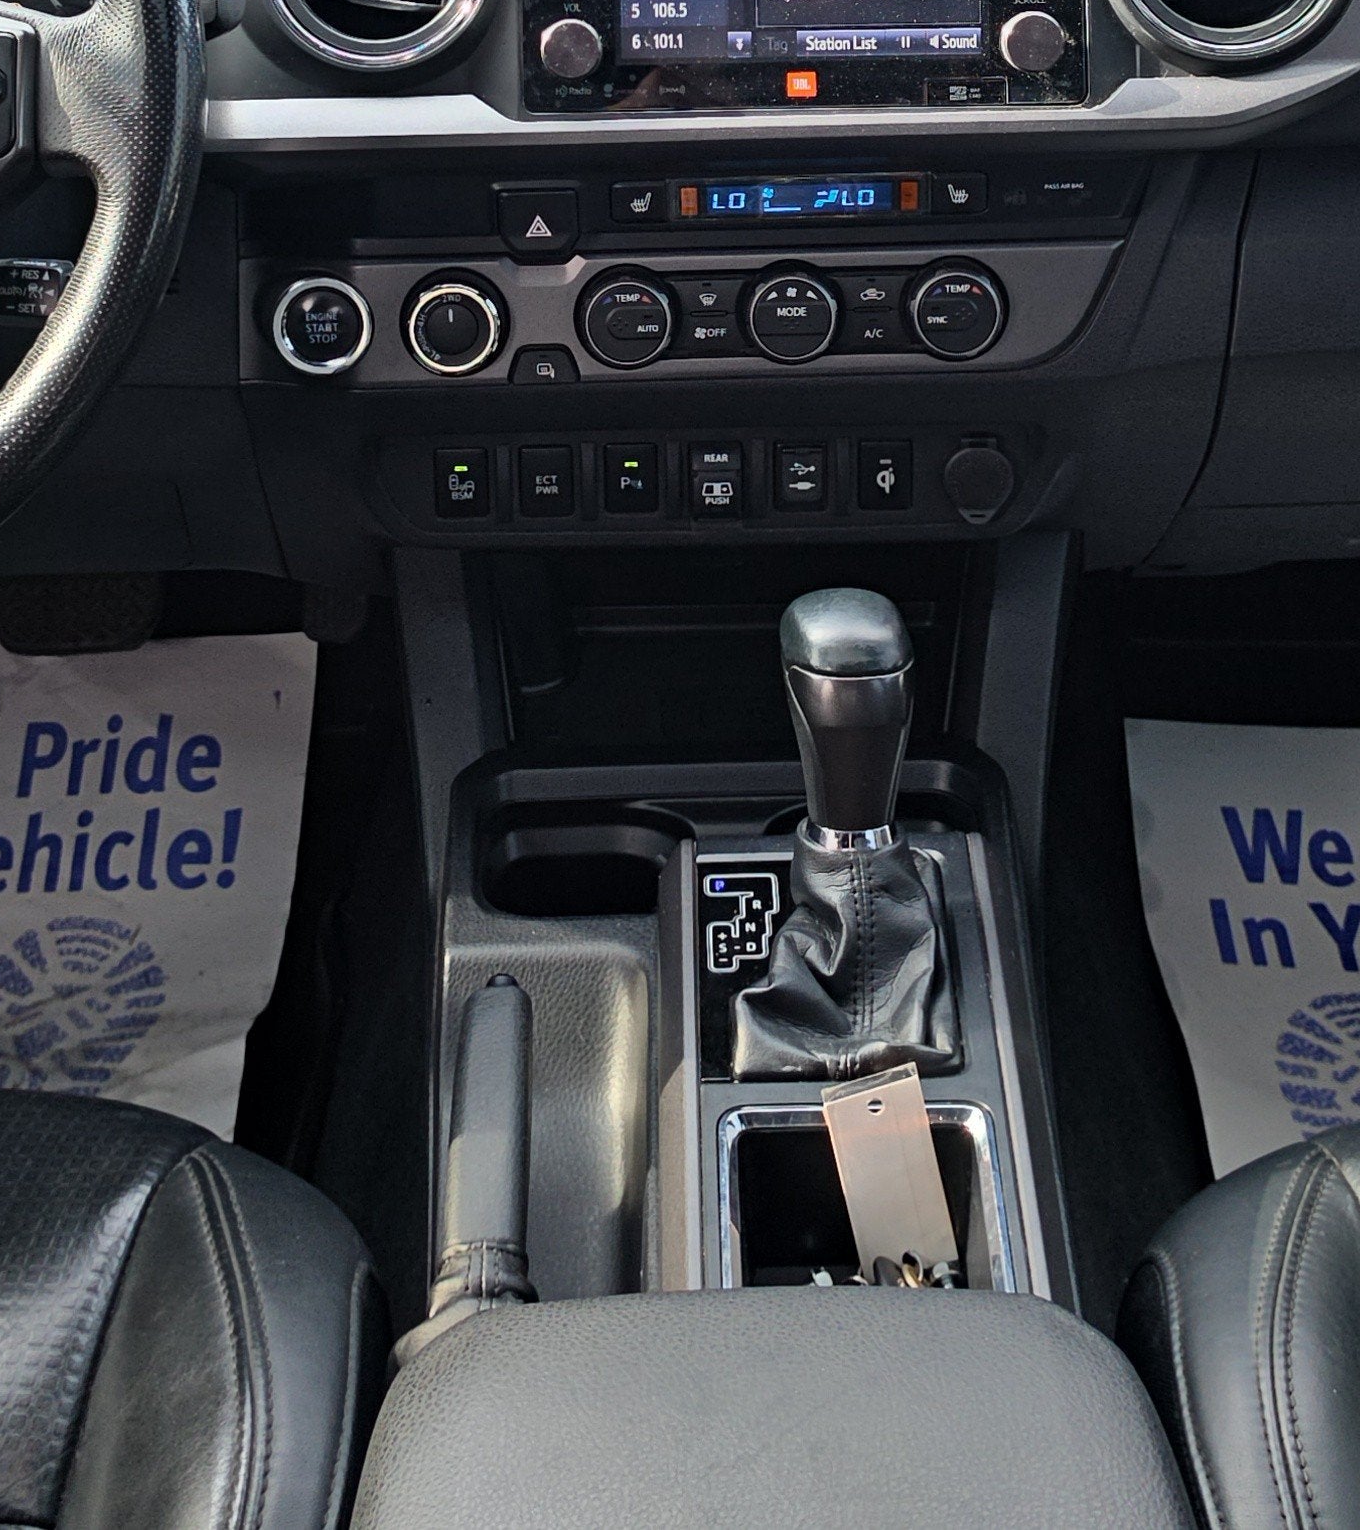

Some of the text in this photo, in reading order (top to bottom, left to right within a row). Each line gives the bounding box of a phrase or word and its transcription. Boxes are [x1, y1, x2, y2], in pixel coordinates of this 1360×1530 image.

[563, 3, 581, 13] VOL
[631, 2, 688, 19] 5 106.5
[631, 33, 683, 50] 6 101.1
[767, 36, 788, 52] Tag
[805, 35, 877, 51] Station List
[941, 33, 978, 49] Sound
[792, 78, 811, 90] JBL
[1060, 182, 1071, 190] AIR
[711, 192, 746, 209] LO
[841, 189, 875, 206] LO
[21, 270, 40, 280] RES
[945, 284, 971, 294] TEMP
[441, 294, 462, 303] 2WD
[614, 294, 641, 303] TEMP
[17, 303, 37, 314] SET
[776, 306, 808, 318] MODE
[305, 312, 338, 321] ENGINE
[926, 316, 949, 324] SYNC
[305, 323, 338, 332] START
[636, 324, 659, 333] AUTO
[706, 328, 727, 338] OFF
[309, 334, 338, 344] STOP
[864, 328, 884, 339] A/C
[703, 453, 729, 463] REAR
[536, 475, 558, 485] ECT
[451, 490, 474, 500] BSM
[535, 485, 559, 495] PWR
[704, 496, 730, 506] PUSH
[16, 713, 222, 797] Pride
[1220, 806, 1354, 888] We
[714, 880, 725, 891] P
[752, 899, 762, 910] R
[744, 922, 756, 933] N
[1209, 897, 1296, 970] In
[718, 942, 728, 953] S
[745, 941, 757, 952] D
